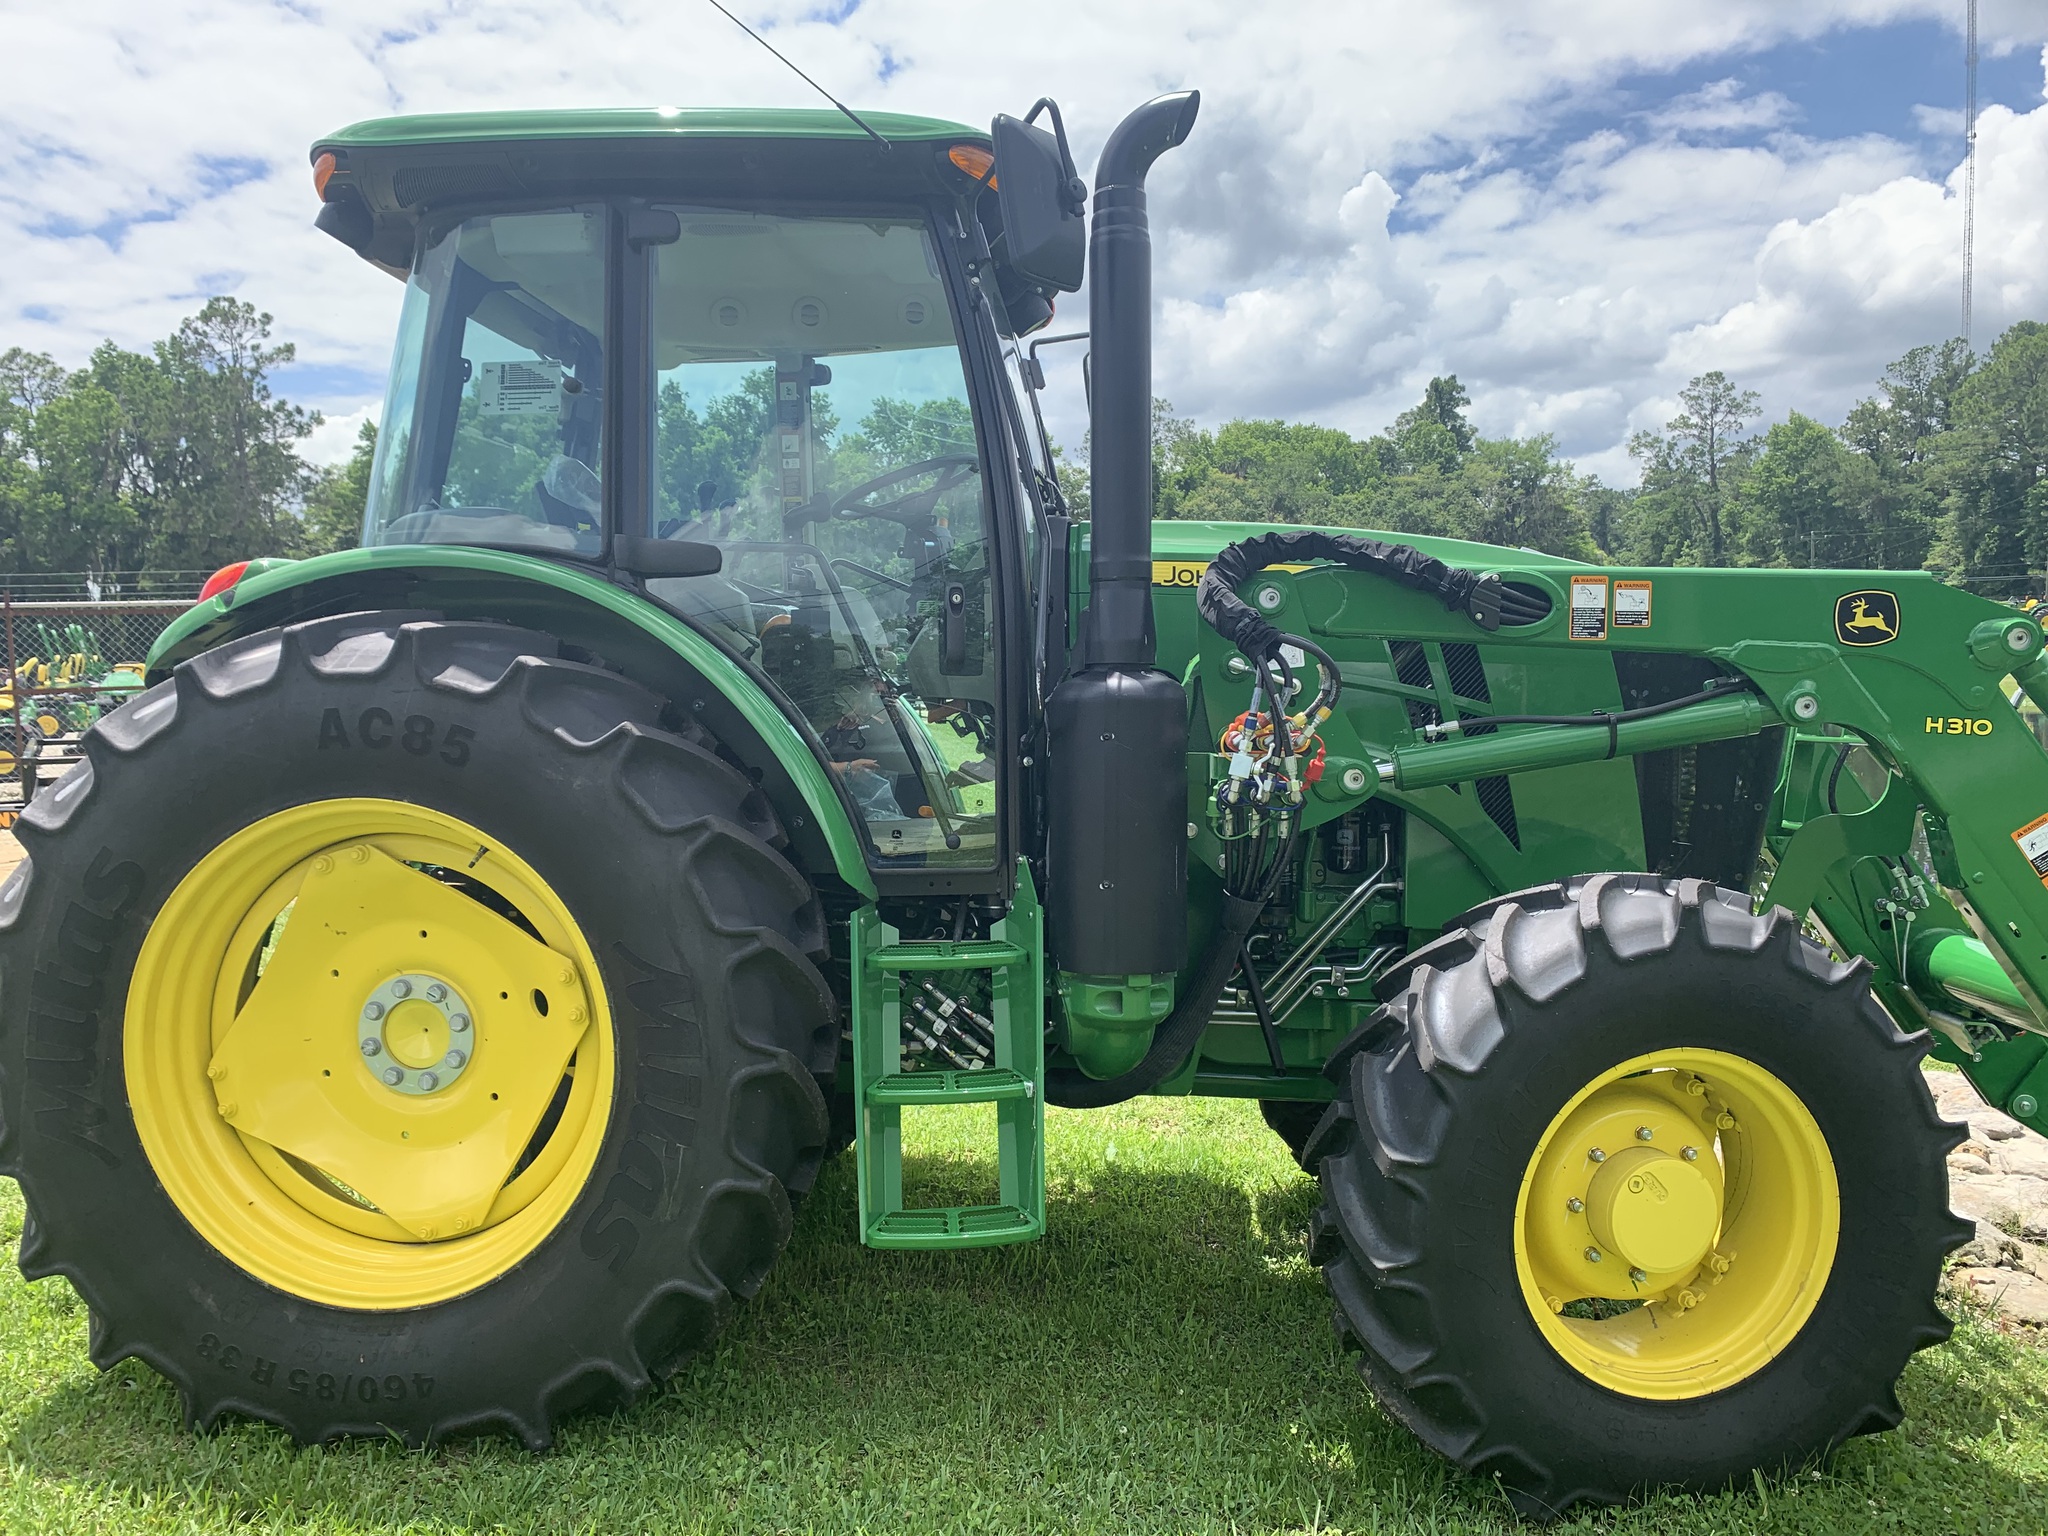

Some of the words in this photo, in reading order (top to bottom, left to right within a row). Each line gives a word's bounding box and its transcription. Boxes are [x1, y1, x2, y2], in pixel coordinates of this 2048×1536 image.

[317, 706, 478, 769] AC85
[1924, 716, 1993, 736] H310
[195, 1331, 244, 1374] 38
[249, 1355, 278, 1389] R
[287, 1368, 436, 1404] 460/85
